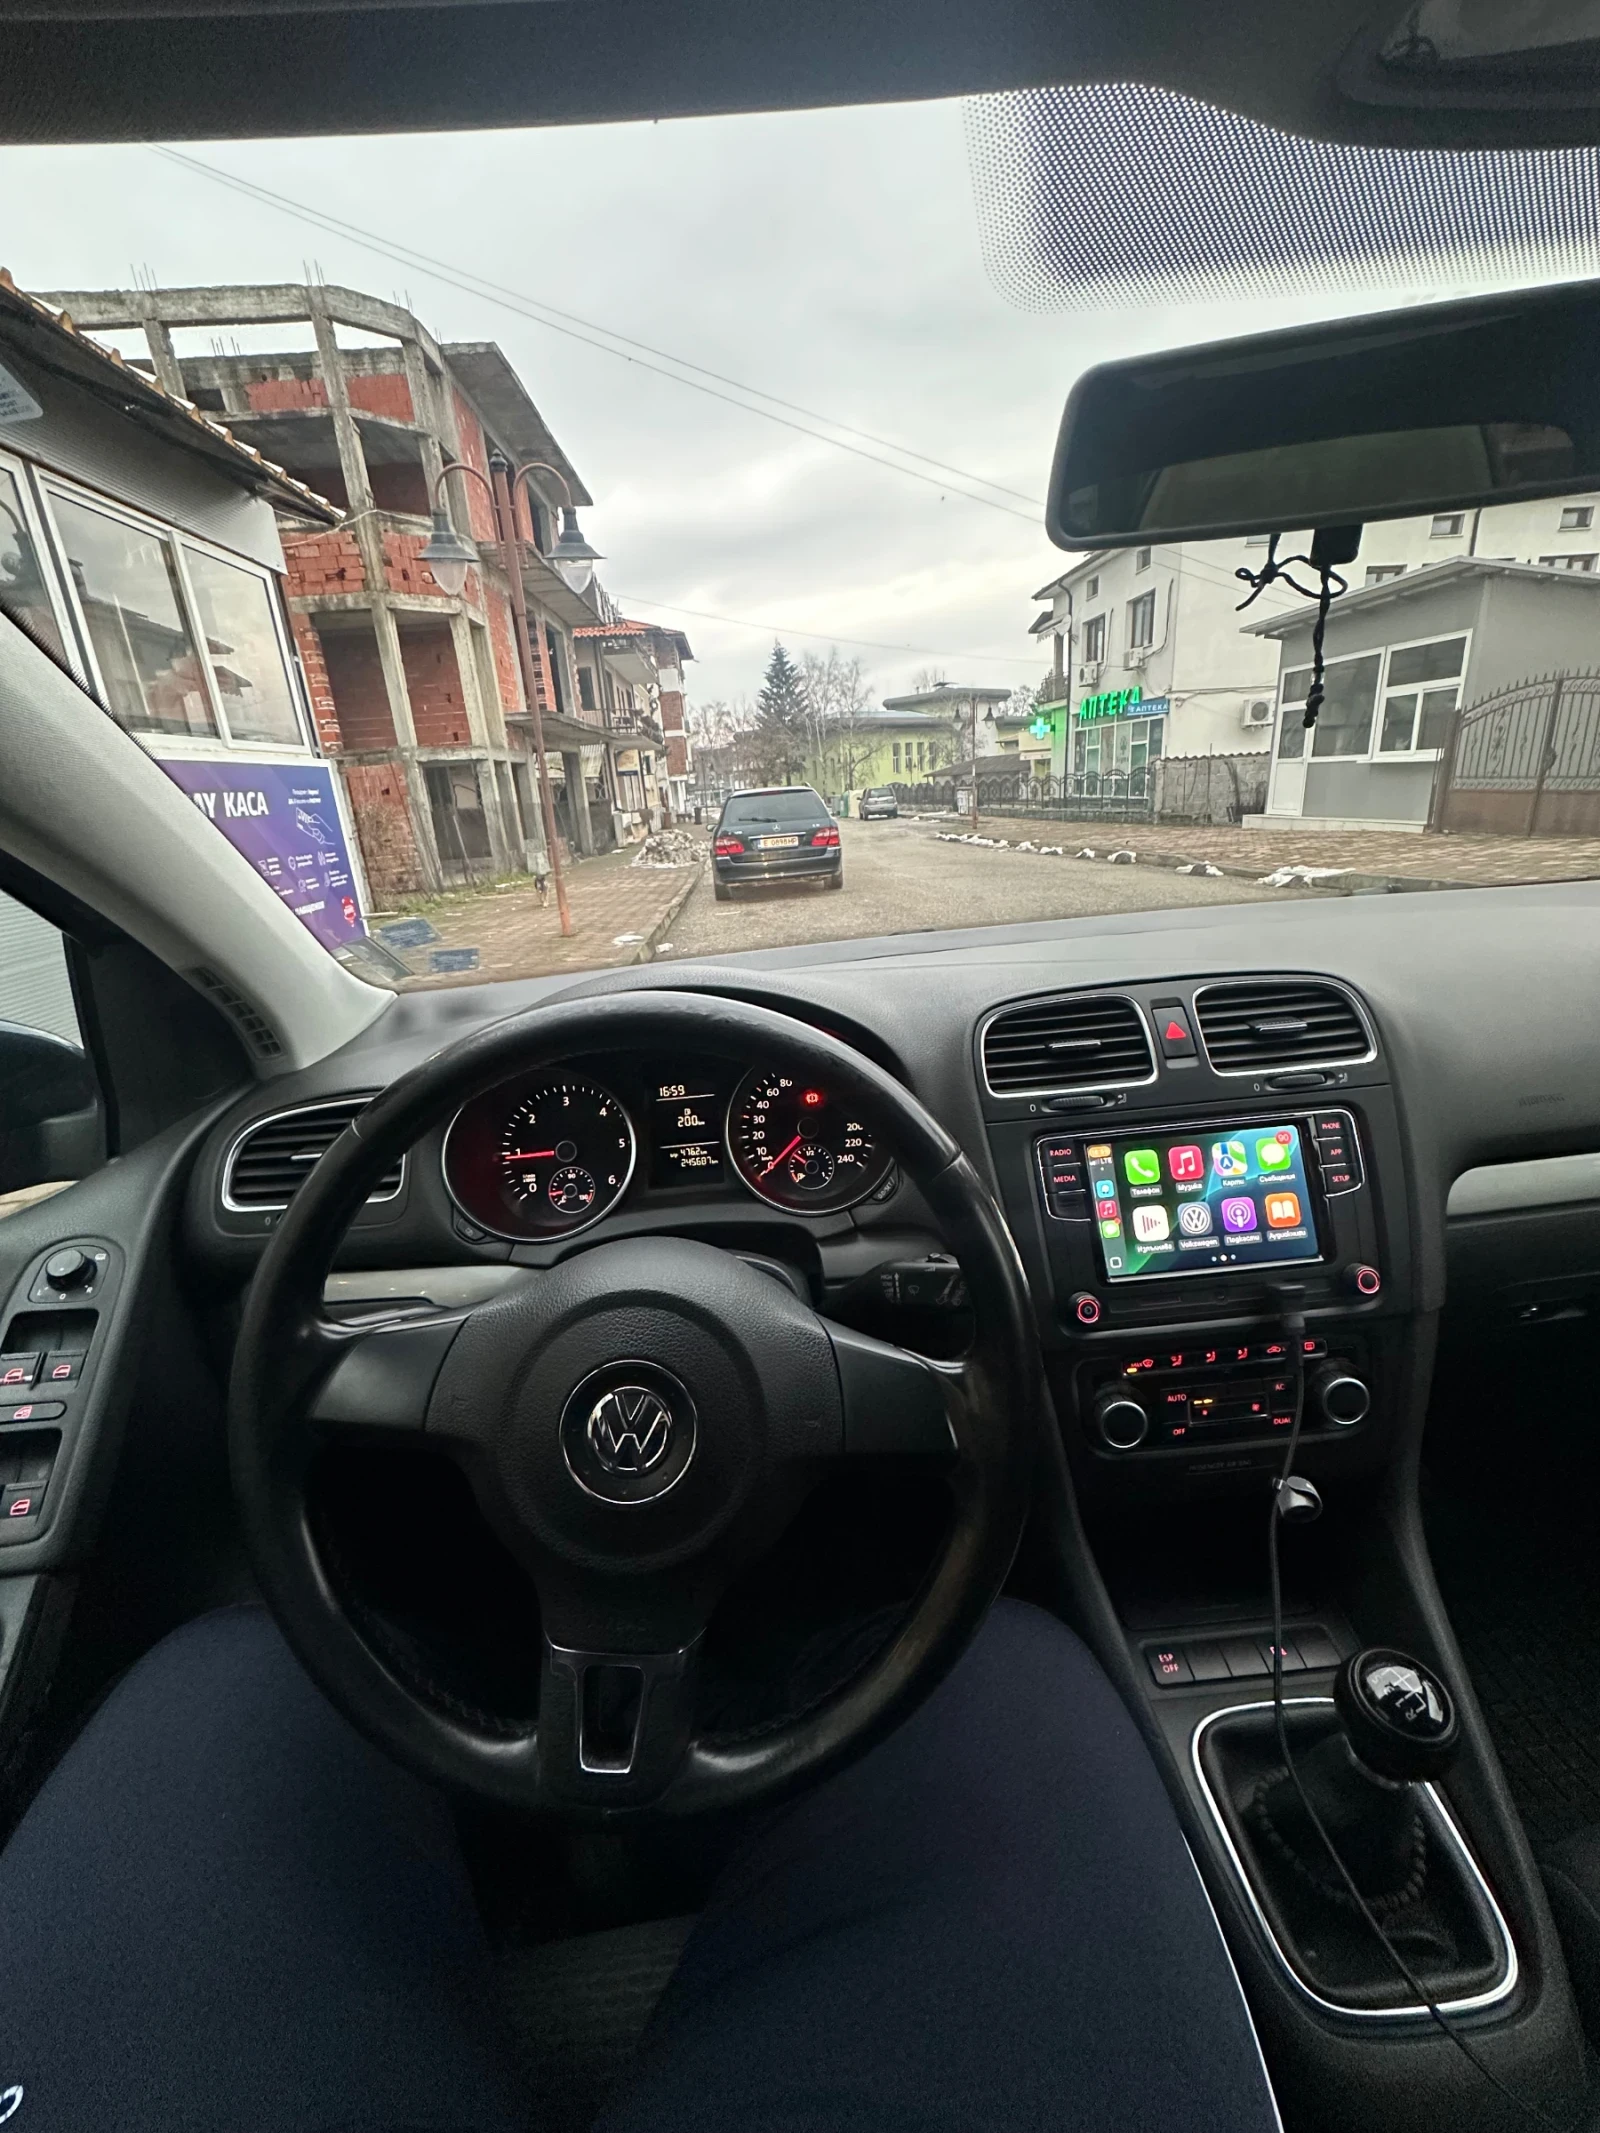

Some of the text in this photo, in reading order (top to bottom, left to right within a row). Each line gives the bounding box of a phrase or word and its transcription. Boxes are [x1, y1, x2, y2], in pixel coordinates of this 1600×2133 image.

[1079, 685, 1142, 720] АПТЕКА
[1135, 703, 1168, 713] АПТЕКА
[222, 791, 270, 818] КАСА
[779, 1078, 793, 1087] 80
[659, 1084, 686, 1097] 16:59
[766, 1087, 780, 1097] 60
[562, 1096, 570, 1106] 3
[756, 1100, 770, 1109] 40
[599, 1107, 607, 1117] 4
[528, 1114, 536, 1124] 2
[753, 1115, 766, 1124] 30
[1321, 1121, 1341, 1130] PHONE
[752, 1130, 765, 1140] 20
[1278, 1133, 1289, 1142] 90
[618, 1138, 626, 1148] 5
[844, 1138, 863, 1148] 220
[515, 1148, 521, 1156] 1
[756, 1146, 767, 1156] 10
[1049, 1148, 1072, 1157] RADIO
[1330, 1148, 1342, 1156] APP
[836, 1154, 855, 1164] 240
[1100, 1157, 1113, 1165] LTE
[767, 1161, 775, 1170] 0
[608, 1174, 616, 1185] 6
[1053, 1175, 1076, 1183] MEDIA
[1222, 1178, 1245, 1187] Карти
[1332, 1174, 1350, 1183] SETUP
[528, 1182, 537, 1193] 0
[1131, 1187, 1161, 1196] Телефон
[1177, 1183, 1203, 1192] Музика
[1180, 1238, 1218, 1248] Volkswagen
[1226, 1234, 1260, 1244] Подкасти
[1274, 1383, 1285, 1391] AC
[1167, 1393, 1187, 1402] AUTO
[1273, 1416, 1292, 1425] DUAL
[1172, 1427, 1186, 1436] OFF
[1158, 1653, 1174, 1663] ESP
[1162, 1663, 1180, 1673] OFF
